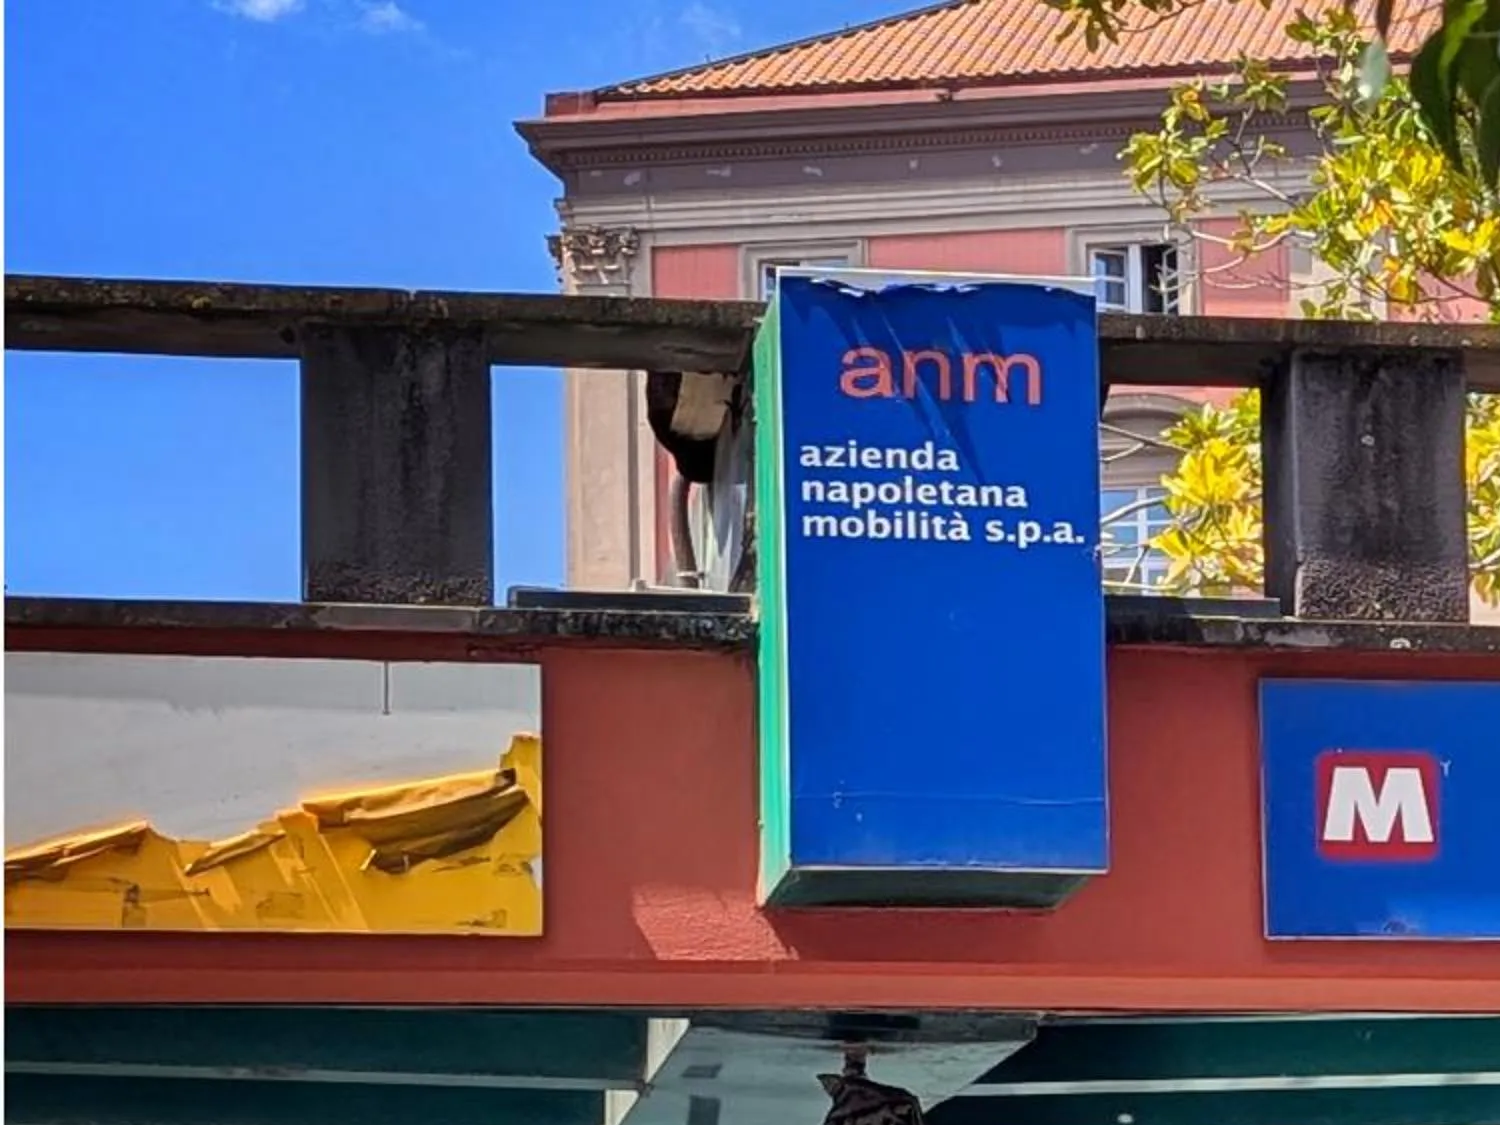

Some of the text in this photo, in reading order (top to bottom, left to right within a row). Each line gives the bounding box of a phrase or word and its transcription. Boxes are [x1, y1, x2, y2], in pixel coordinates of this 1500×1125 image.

[839, 345, 1042, 405] anm
[800, 439, 959, 471] azienda
[801, 476, 1028, 509] napoletana
[803, 510, 971, 541] mobilità
[985, 520, 1085, 549] s.p.a.
[1323, 766, 1434, 843] M
